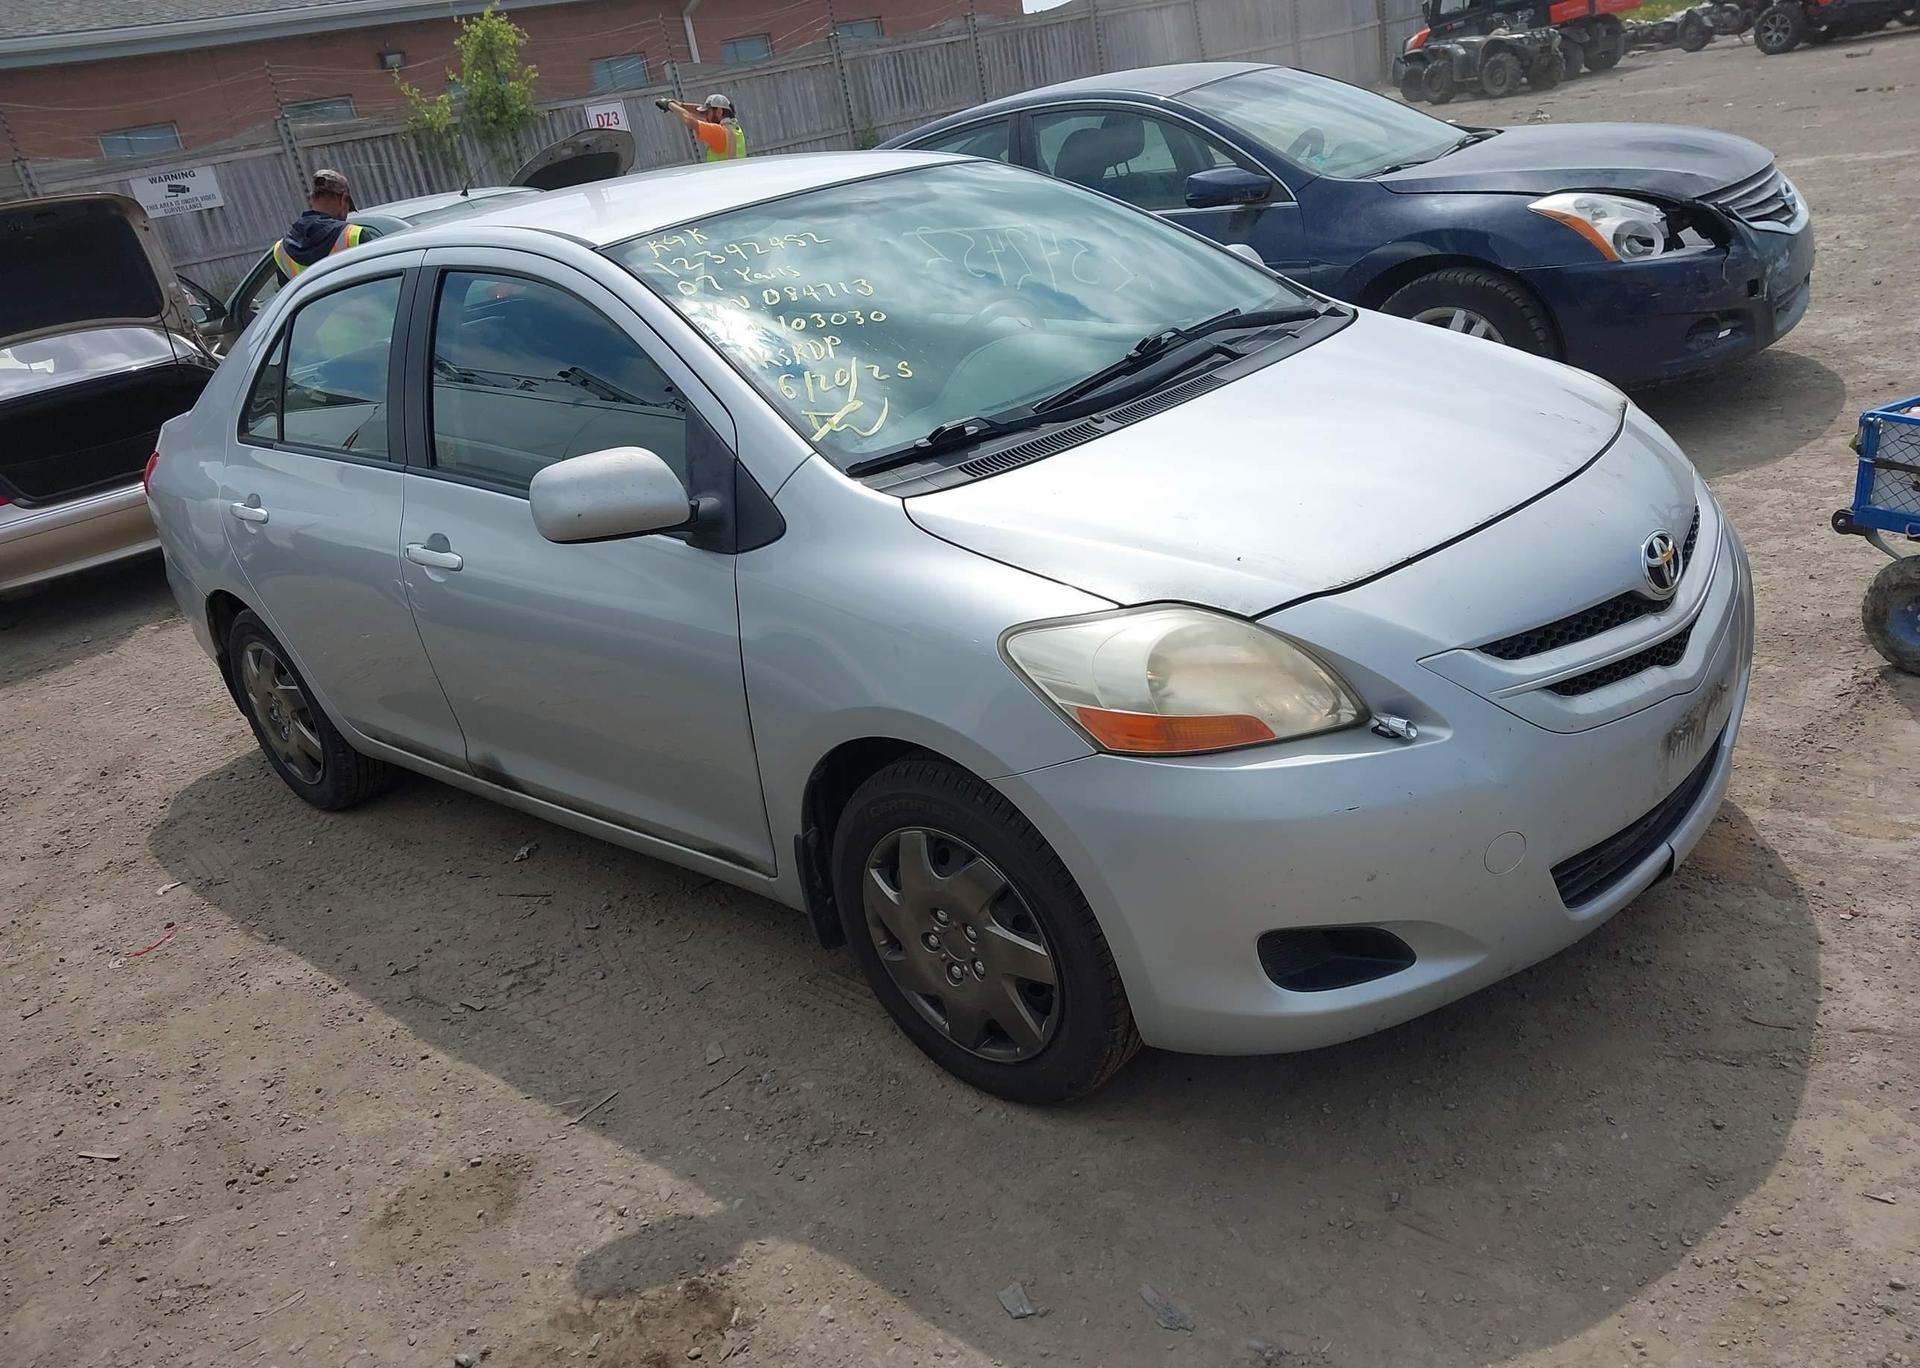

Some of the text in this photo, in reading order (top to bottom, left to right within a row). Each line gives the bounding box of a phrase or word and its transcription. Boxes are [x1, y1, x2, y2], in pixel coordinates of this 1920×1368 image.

[595, 111, 620, 128] DZ3
[148, 169, 196, 185] WARNING
[146, 203, 159, 212] THIS
[160, 200, 174, 210] AREA
[181, 196, 200, 206] UNDER
[200, 193, 217, 203] VIDEO
[163, 202, 203, 215] SURVEILLANCE
[676, 274, 723, 297] 07
